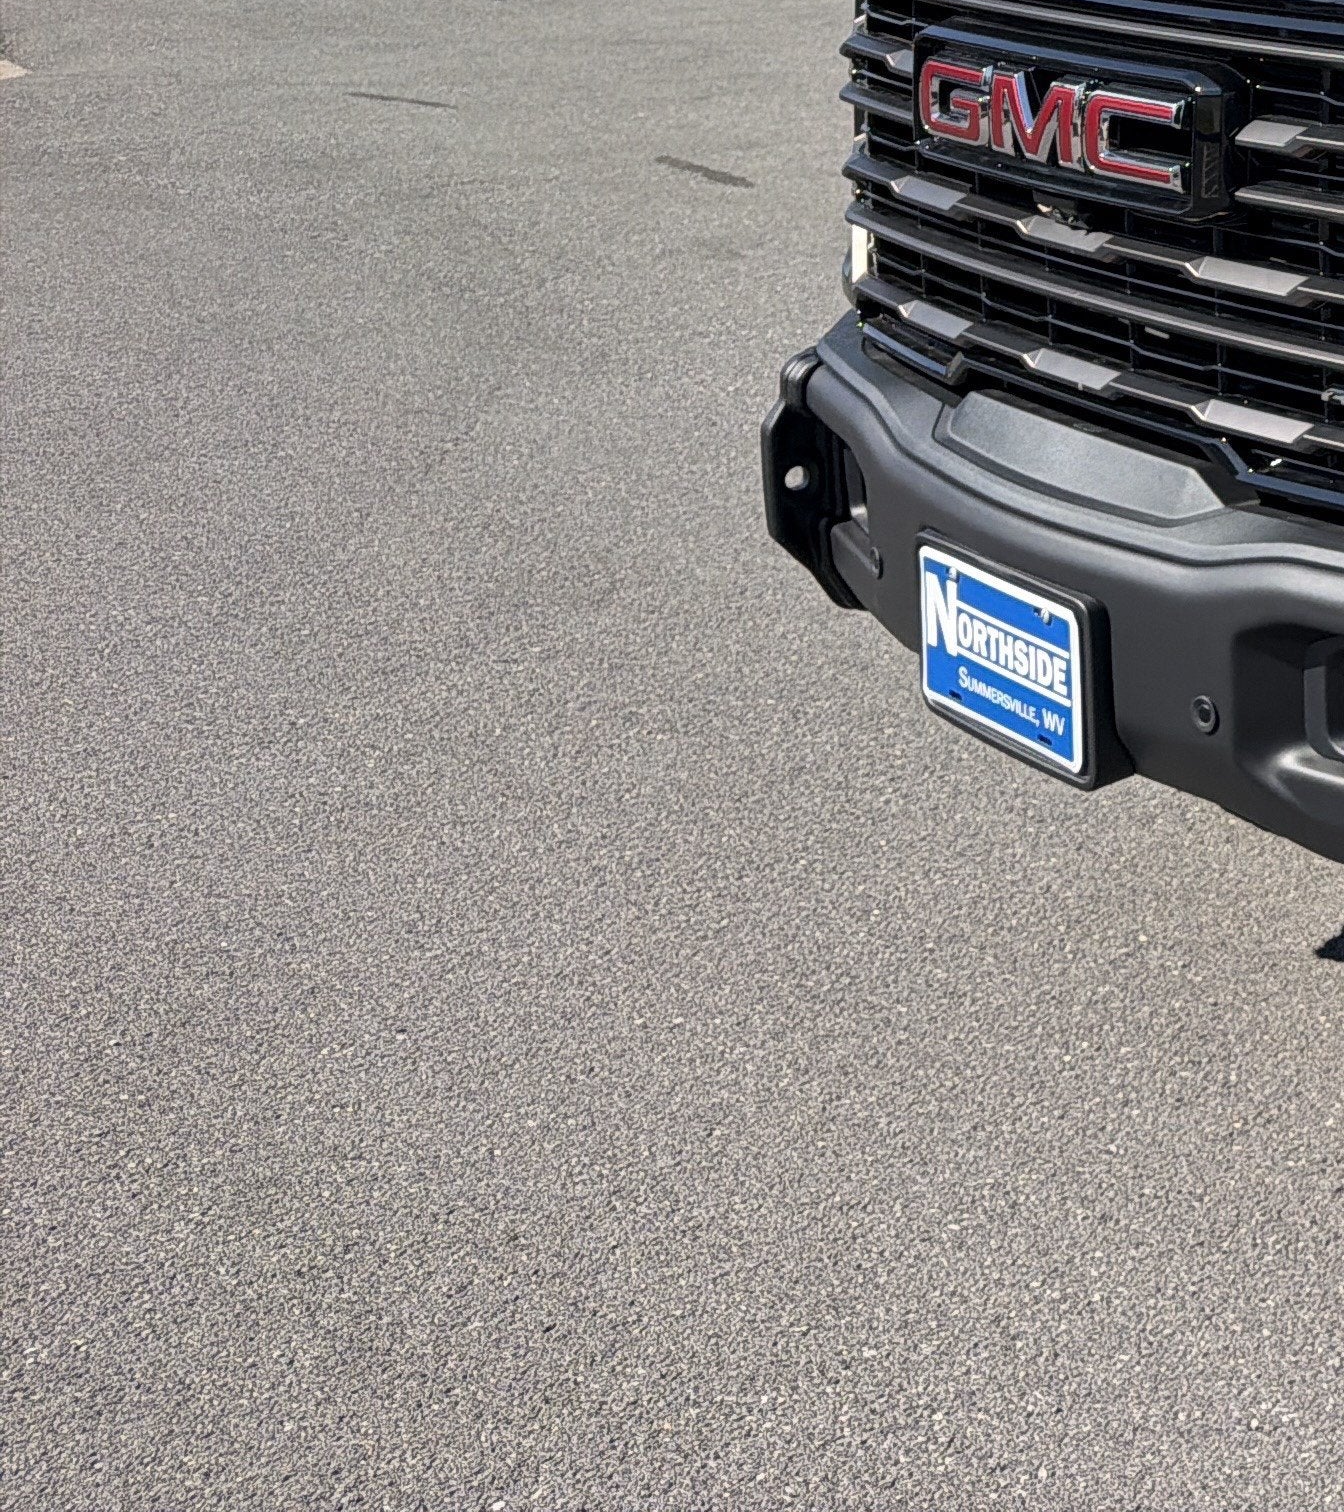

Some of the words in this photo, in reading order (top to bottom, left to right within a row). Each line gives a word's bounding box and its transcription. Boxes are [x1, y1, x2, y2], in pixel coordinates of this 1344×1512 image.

[919, 50, 1187, 194] GMC
[925, 570, 1069, 697] NORTHSIDE
[1042, 707, 1067, 737] WV
